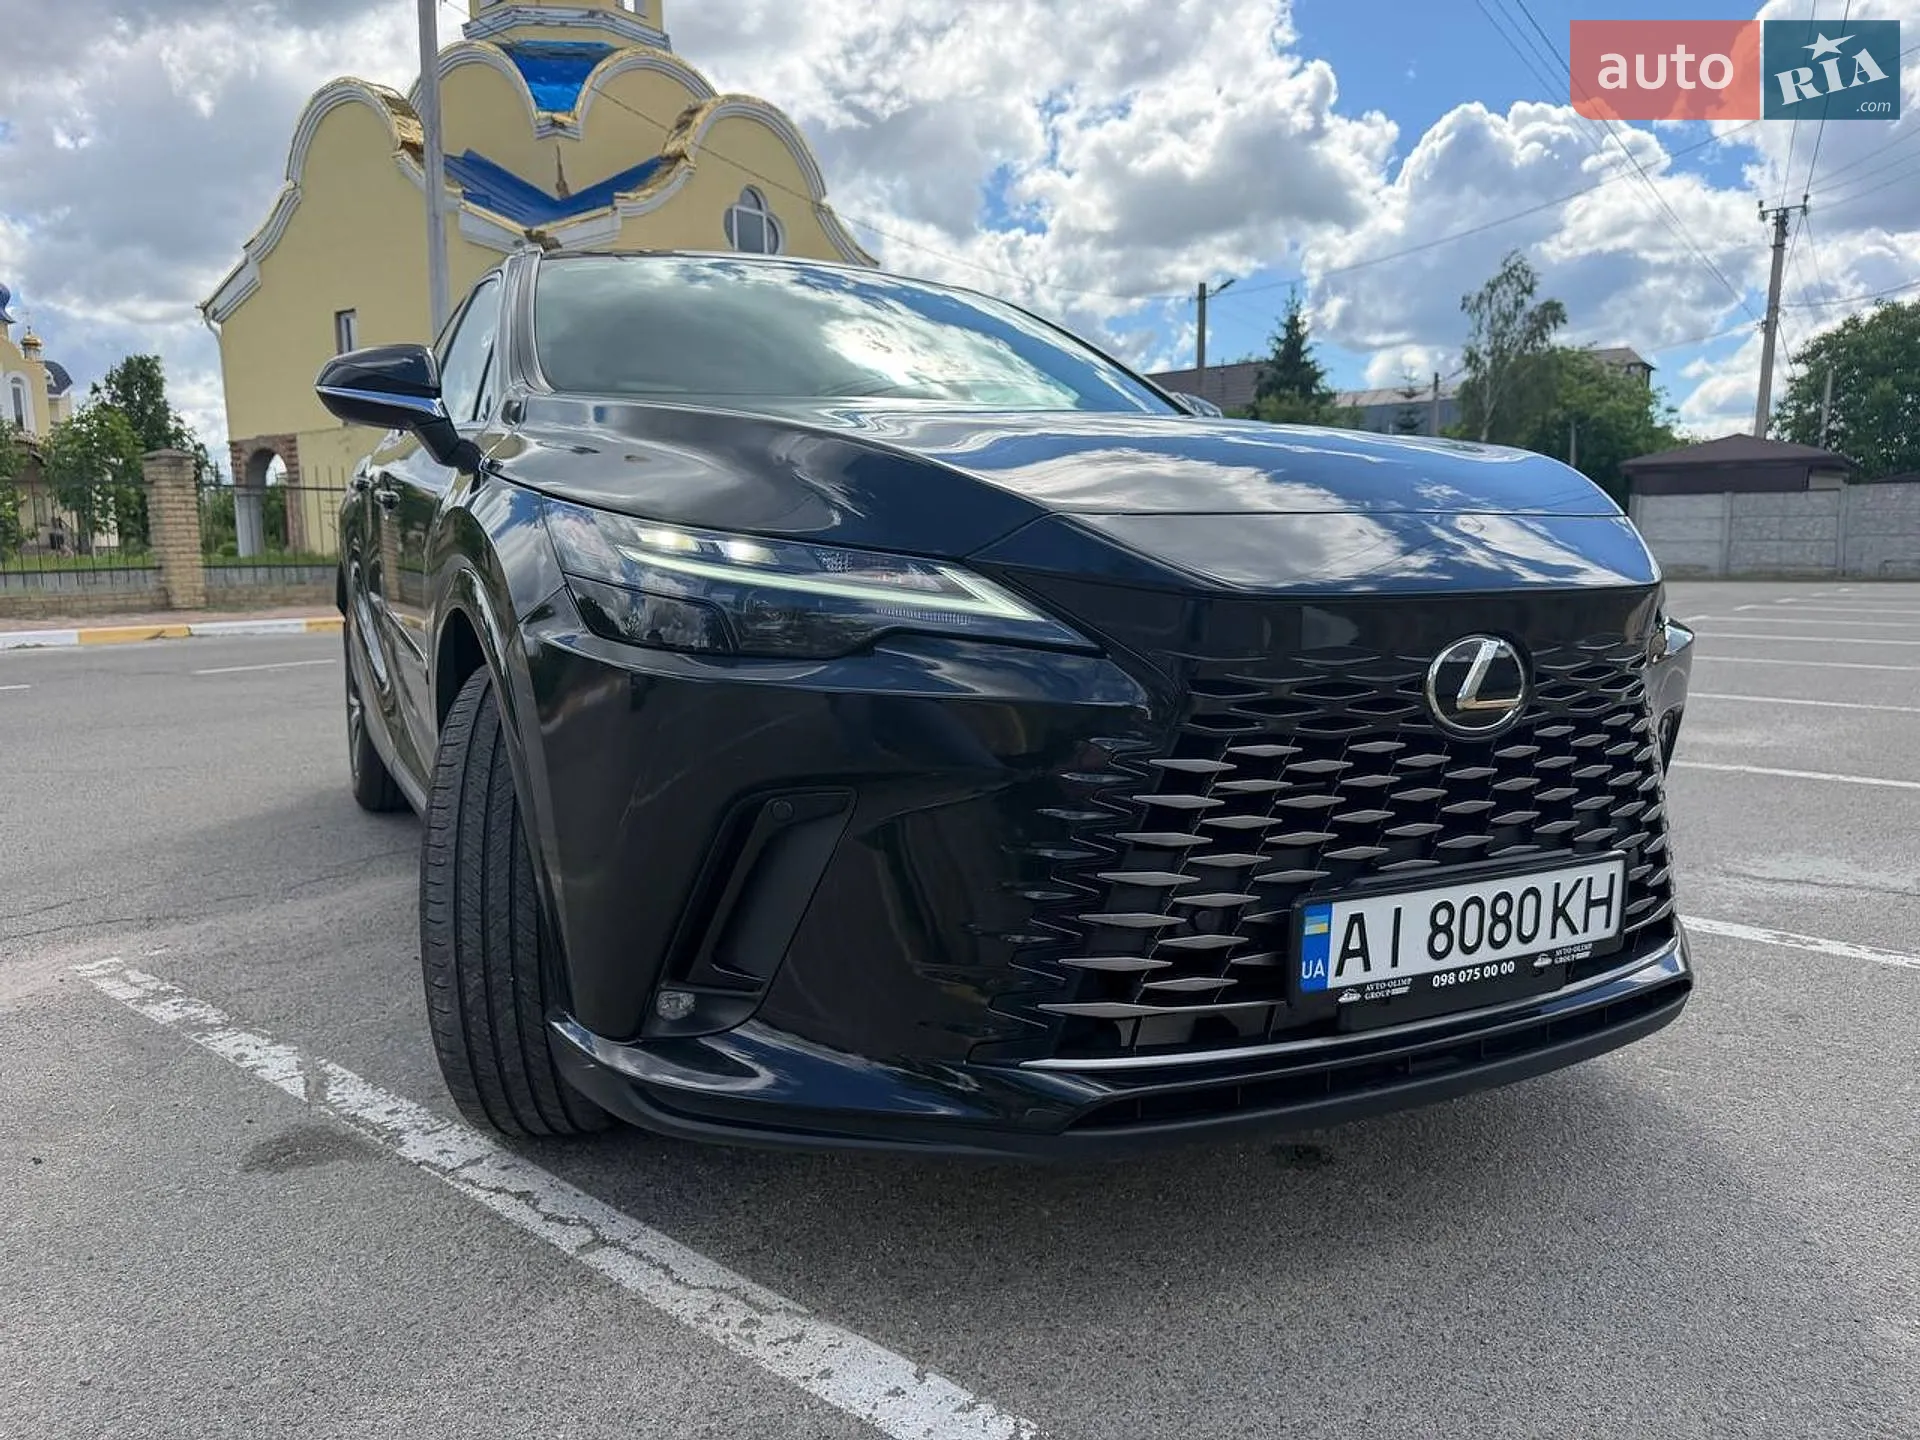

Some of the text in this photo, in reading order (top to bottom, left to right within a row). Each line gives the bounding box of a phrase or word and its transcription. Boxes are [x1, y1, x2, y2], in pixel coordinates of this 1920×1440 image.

[1427, 887, 1541, 961] 8080
[1550, 873, 1615, 939] KH
[1302, 959, 1325, 980] UA
[1432, 961, 1515, 988] 098 075 00 00
